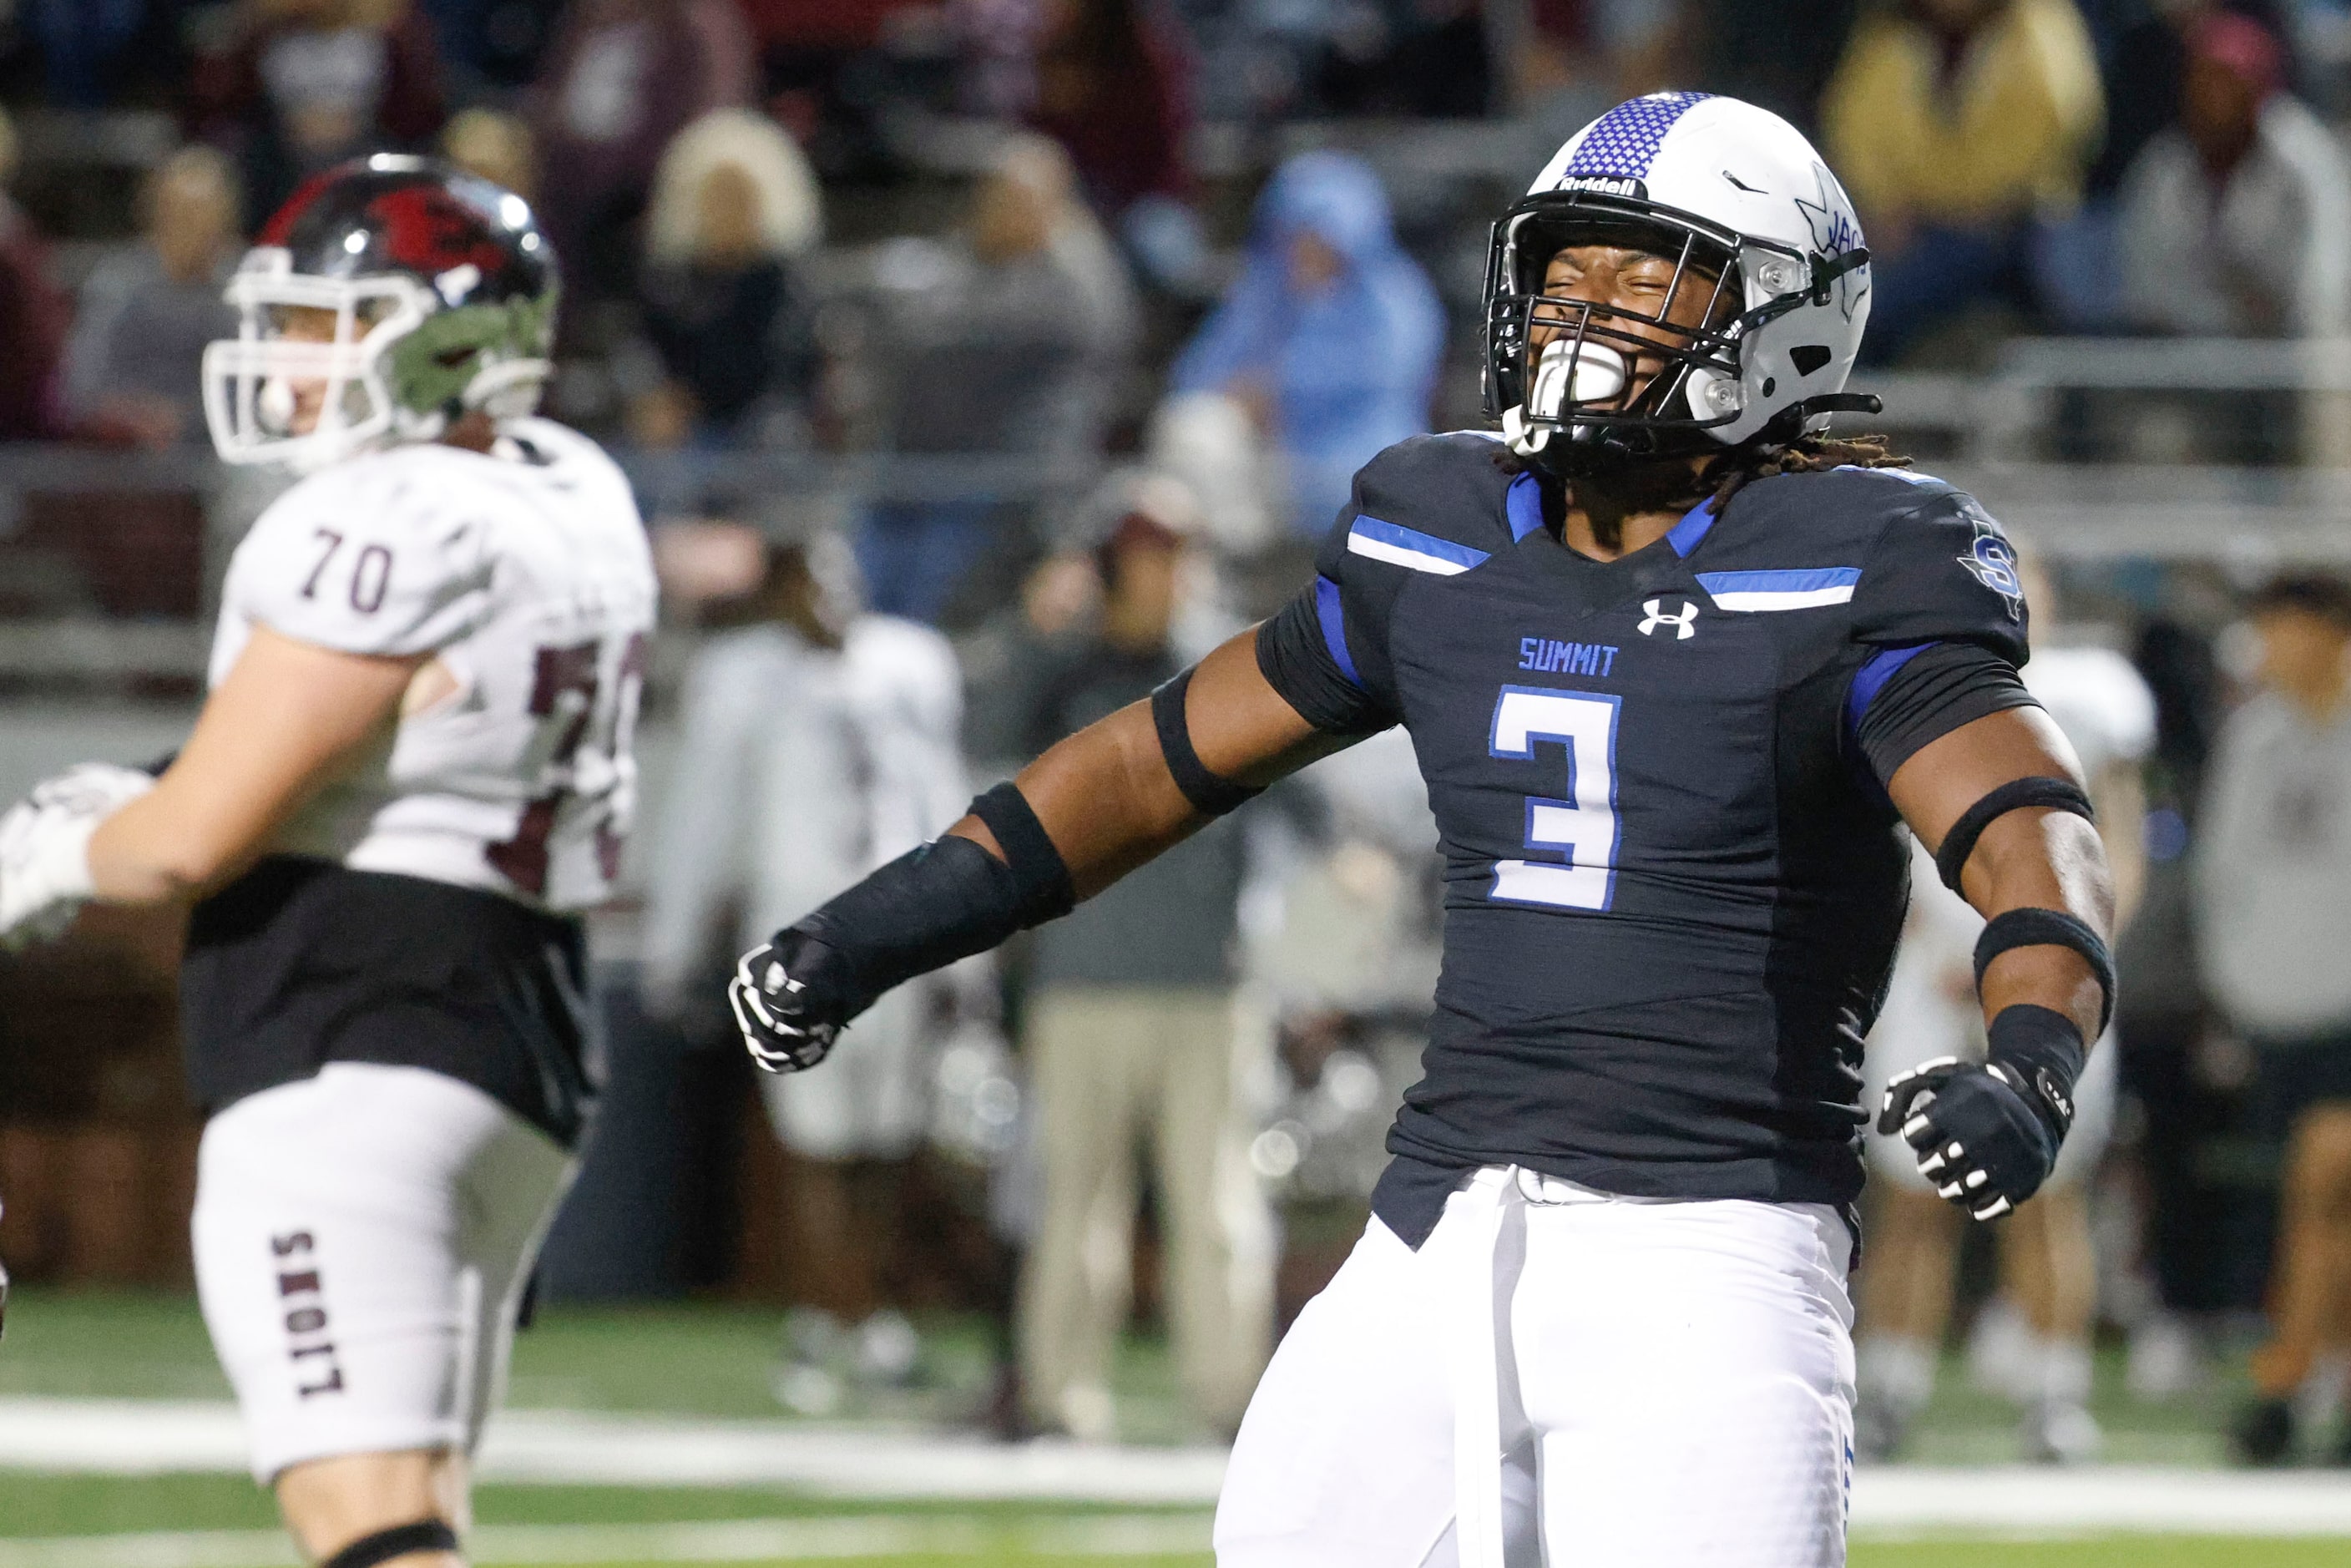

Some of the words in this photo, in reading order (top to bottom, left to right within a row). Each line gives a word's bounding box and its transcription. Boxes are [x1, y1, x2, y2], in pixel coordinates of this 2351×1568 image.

[1558, 175, 1636, 197] Riddell
[300, 527, 394, 615] 70
[1973, 534, 2023, 599] S
[1518, 636, 1619, 677] SUMMIT
[1487, 683, 1623, 913] 3
